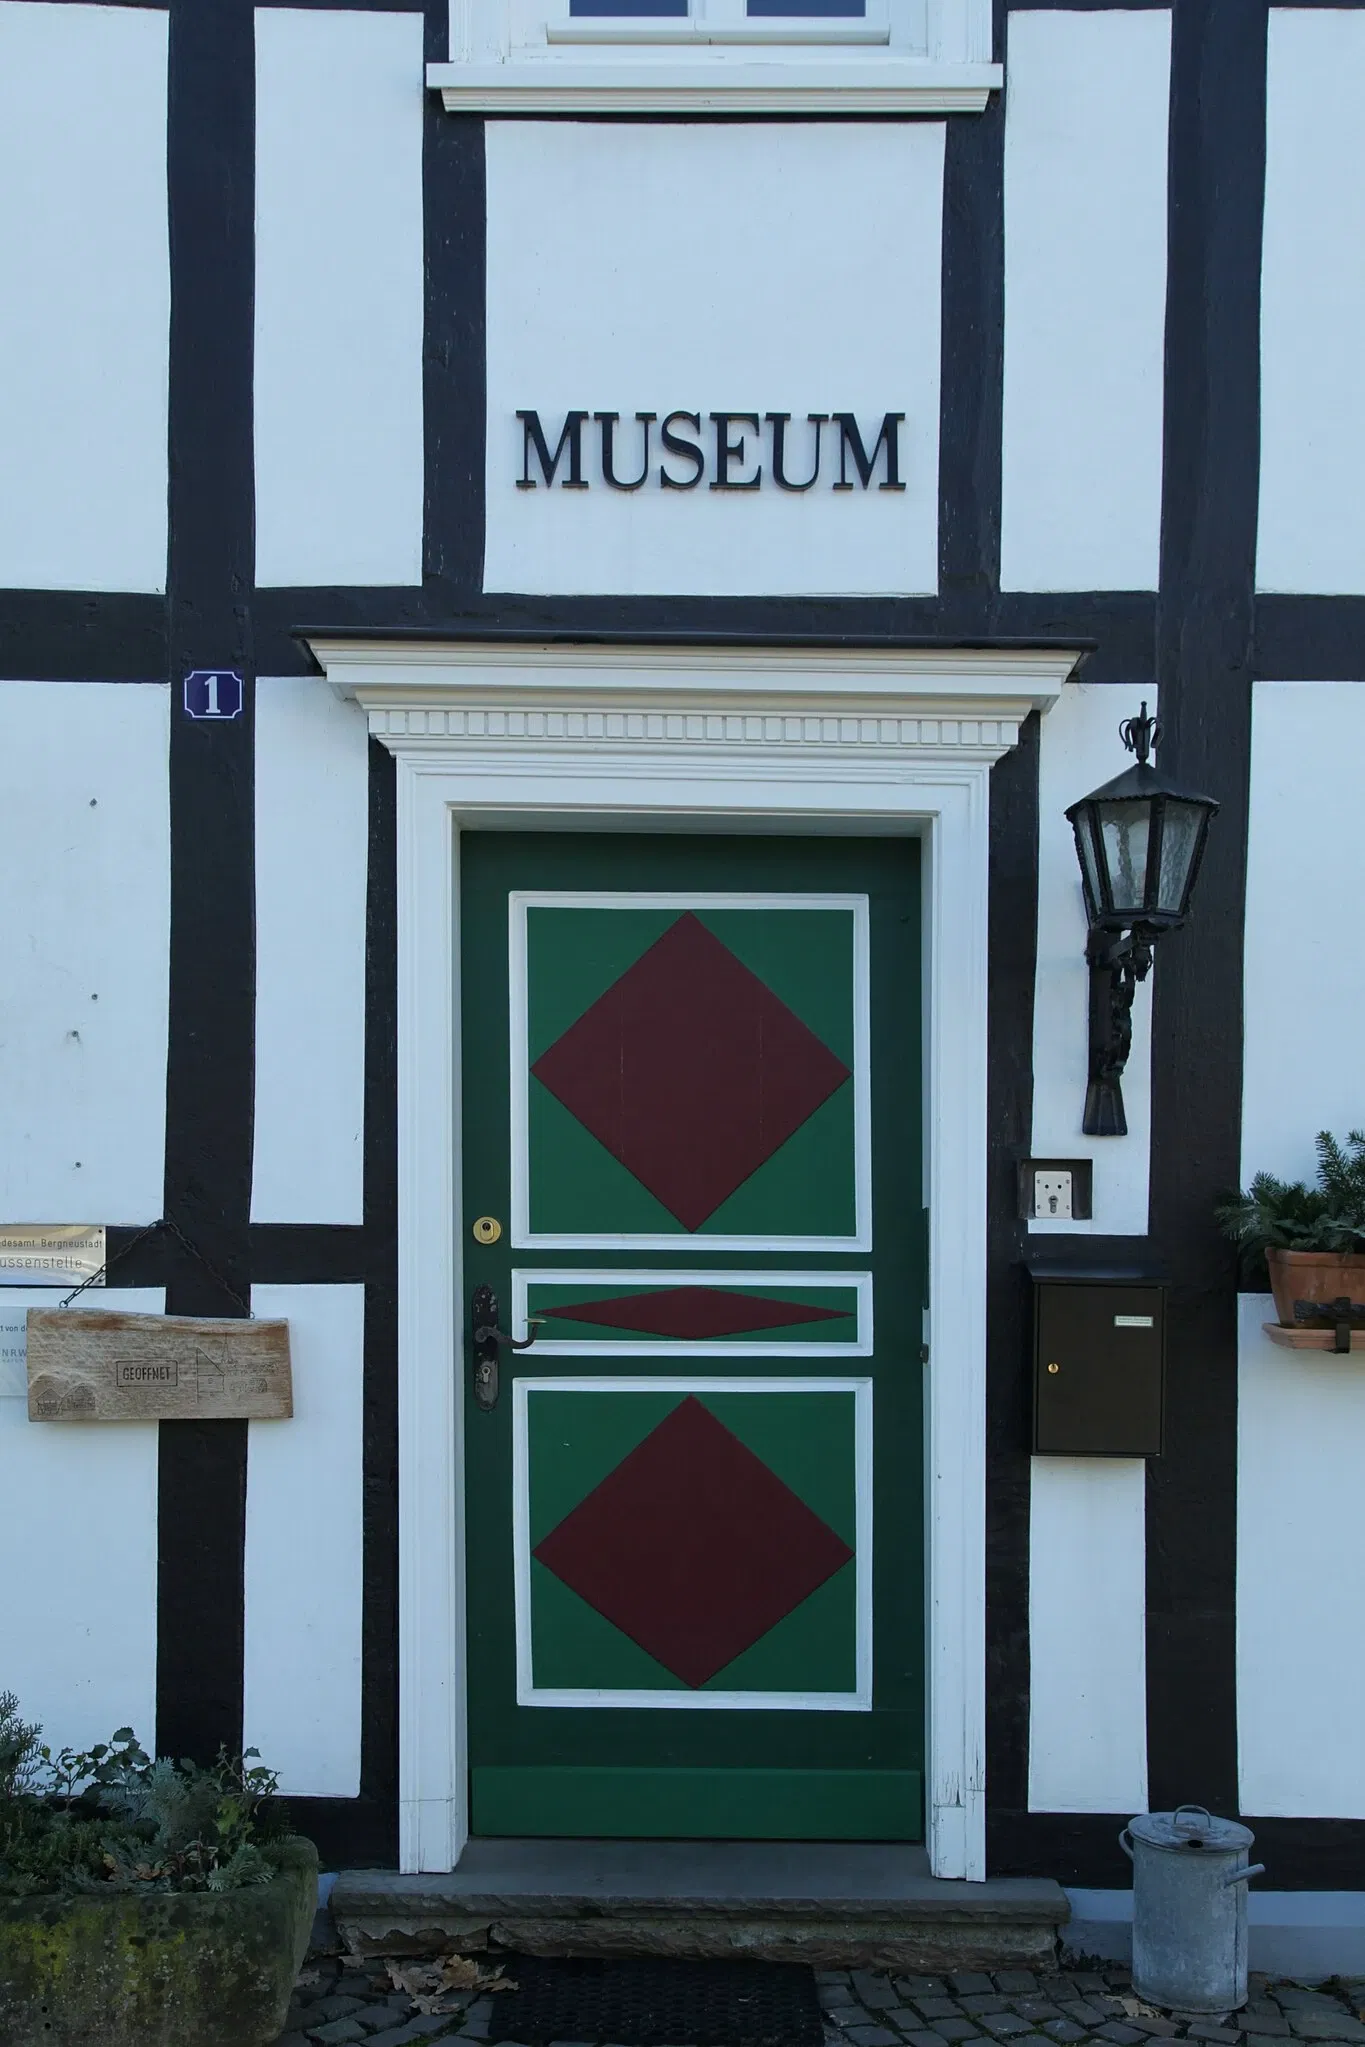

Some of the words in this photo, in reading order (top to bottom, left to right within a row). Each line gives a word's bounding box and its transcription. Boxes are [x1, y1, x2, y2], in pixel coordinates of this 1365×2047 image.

[516, 410, 906, 491] MUSEUM
[204, 676, 221, 713] 1
[41, 1239, 102, 1249] Bergneustadt
